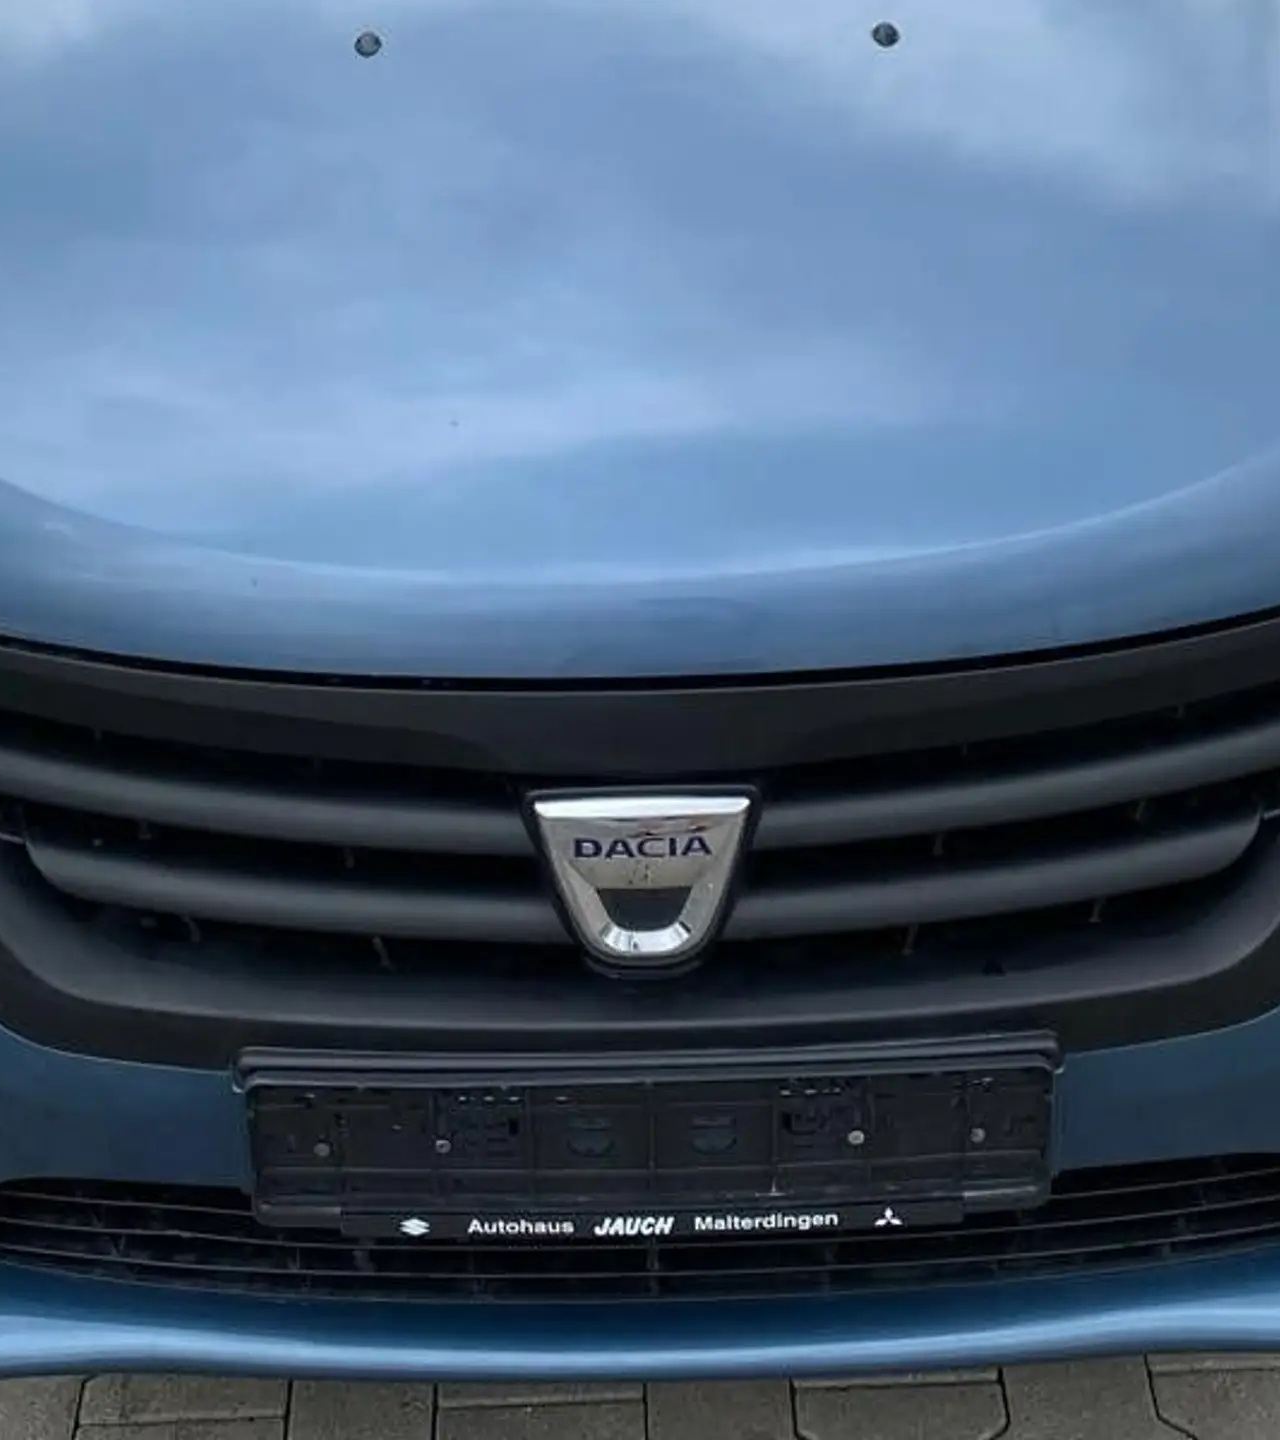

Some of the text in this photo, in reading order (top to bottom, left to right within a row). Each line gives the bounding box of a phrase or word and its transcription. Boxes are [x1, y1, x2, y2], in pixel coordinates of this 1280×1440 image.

[573, 835, 713, 858] DACIA
[467, 1212, 839, 1236] Autohaus JAUCH Malterdingen
